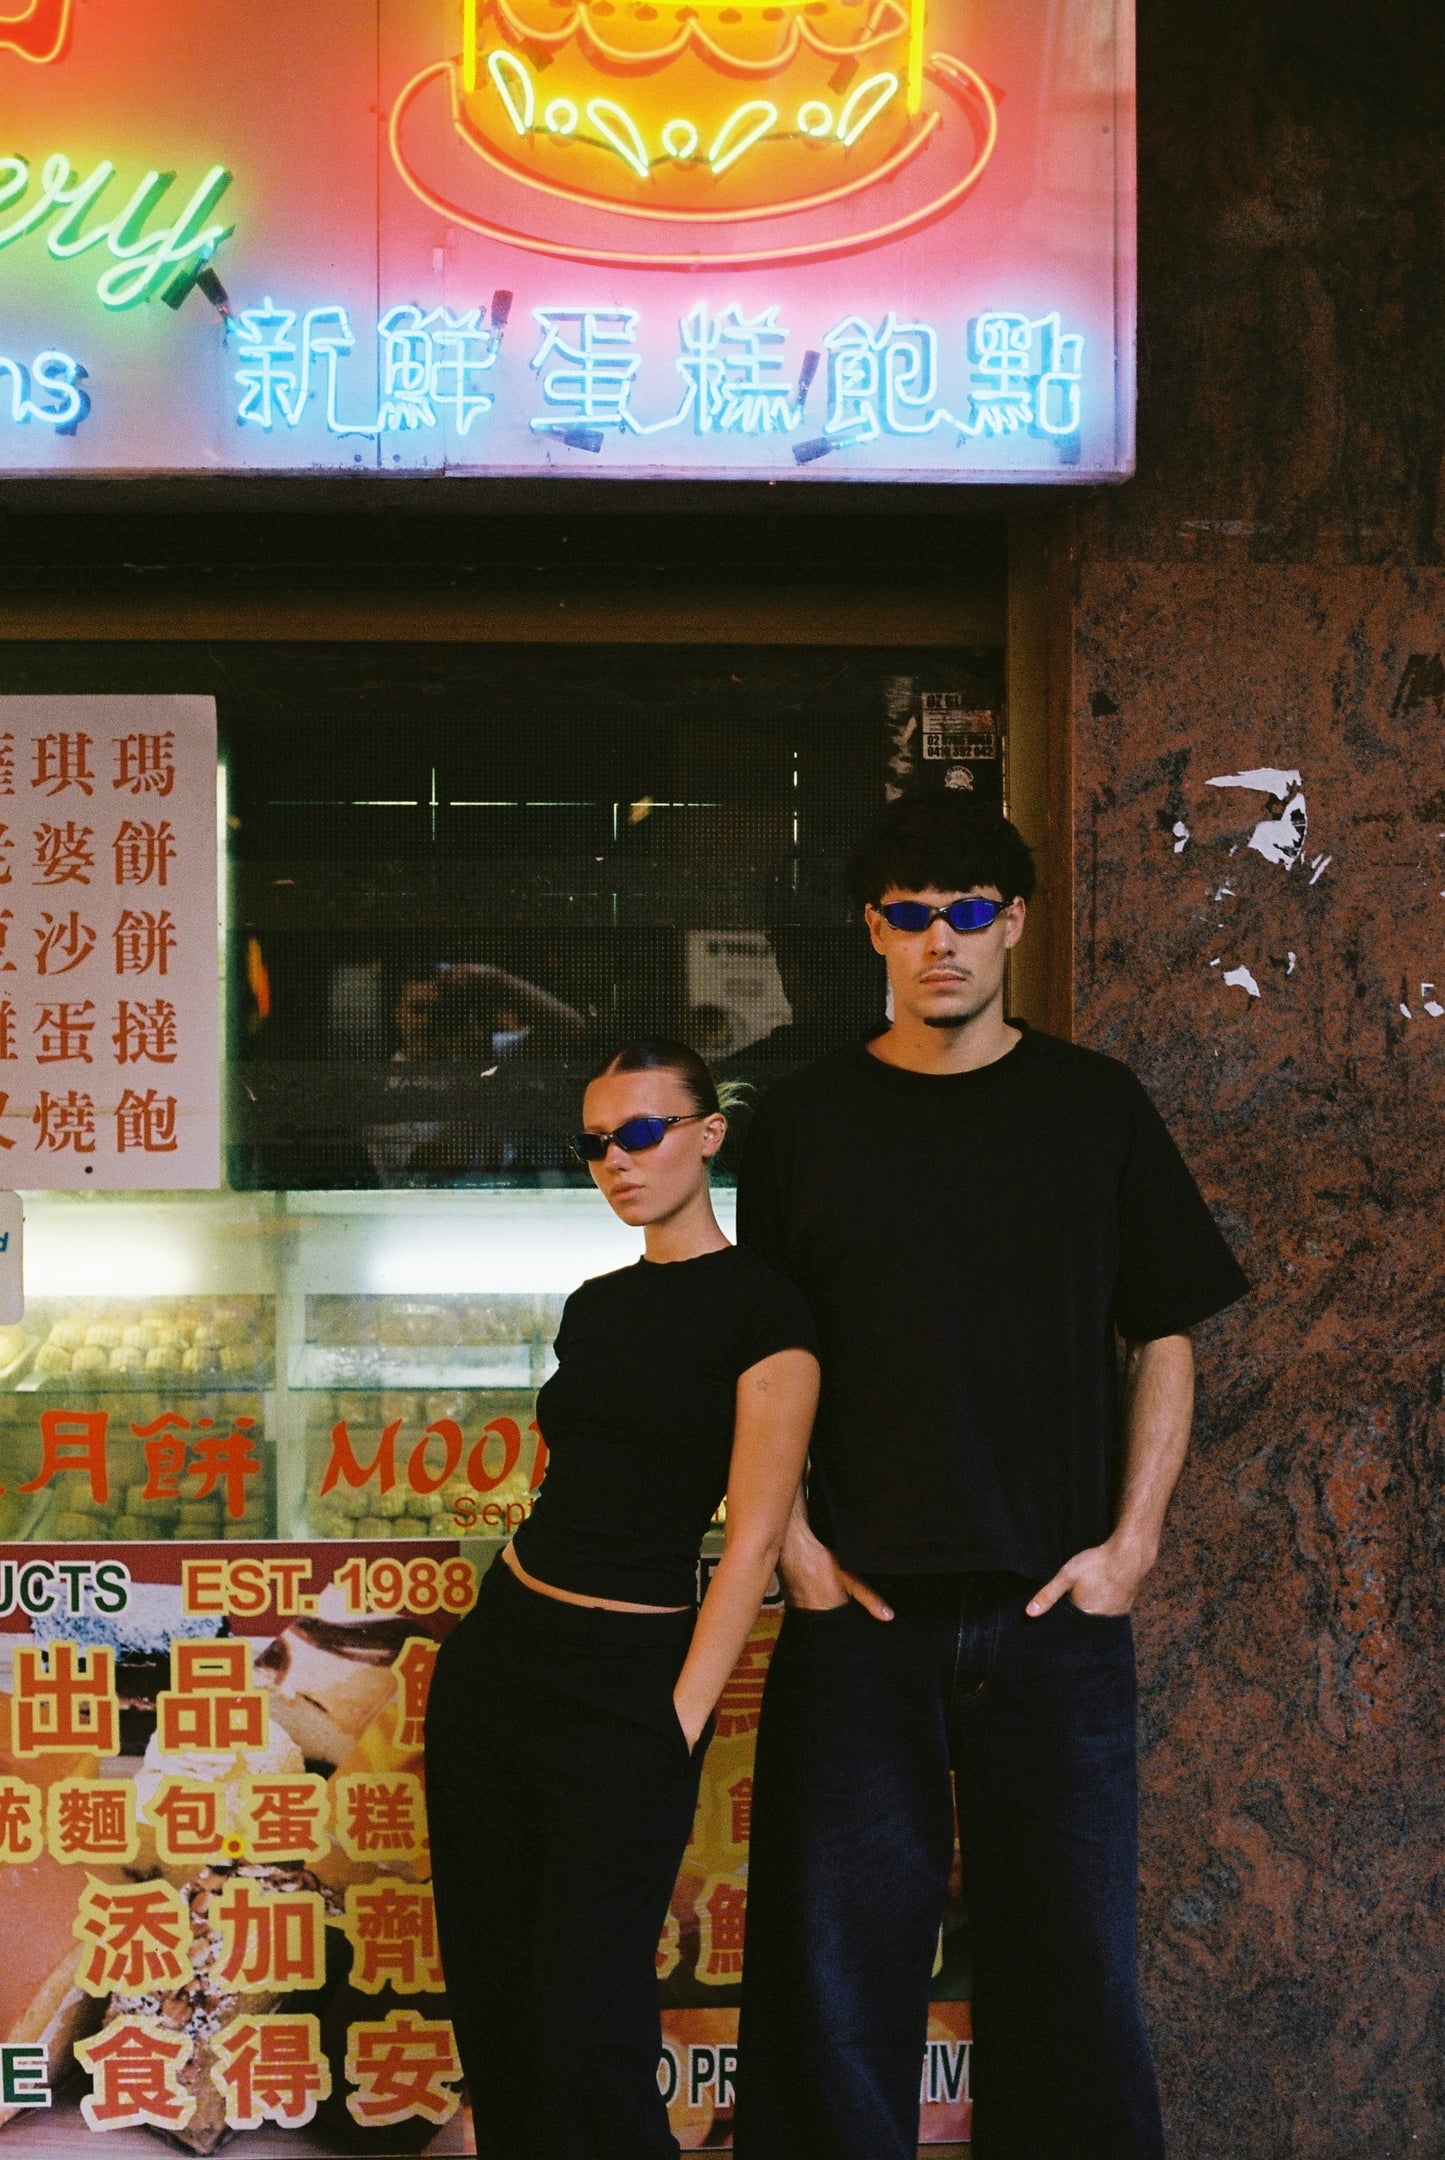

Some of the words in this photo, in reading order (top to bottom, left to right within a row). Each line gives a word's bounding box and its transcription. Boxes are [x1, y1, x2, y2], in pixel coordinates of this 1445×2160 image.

[233, 296, 1084, 436] 新鮮蛋糕飽點
[0, 731, 177, 798] 琪瑪
[0, 820, 178, 887] 婆餅
[0, 909, 178, 977] 沙餅
[0, 999, 179, 1066] 蛋撻
[0, 1087, 179, 1155] 燒飽
[0, 1408, 262, 1519] 月餅
[184, 1560, 318, 1613] EST.
[337, 1559, 475, 1612] 1988
[83, 1887, 447, 1987] 添加劑
[85, 2019, 455, 2122] 食得安
[923, 2044, 974, 2100] IV
